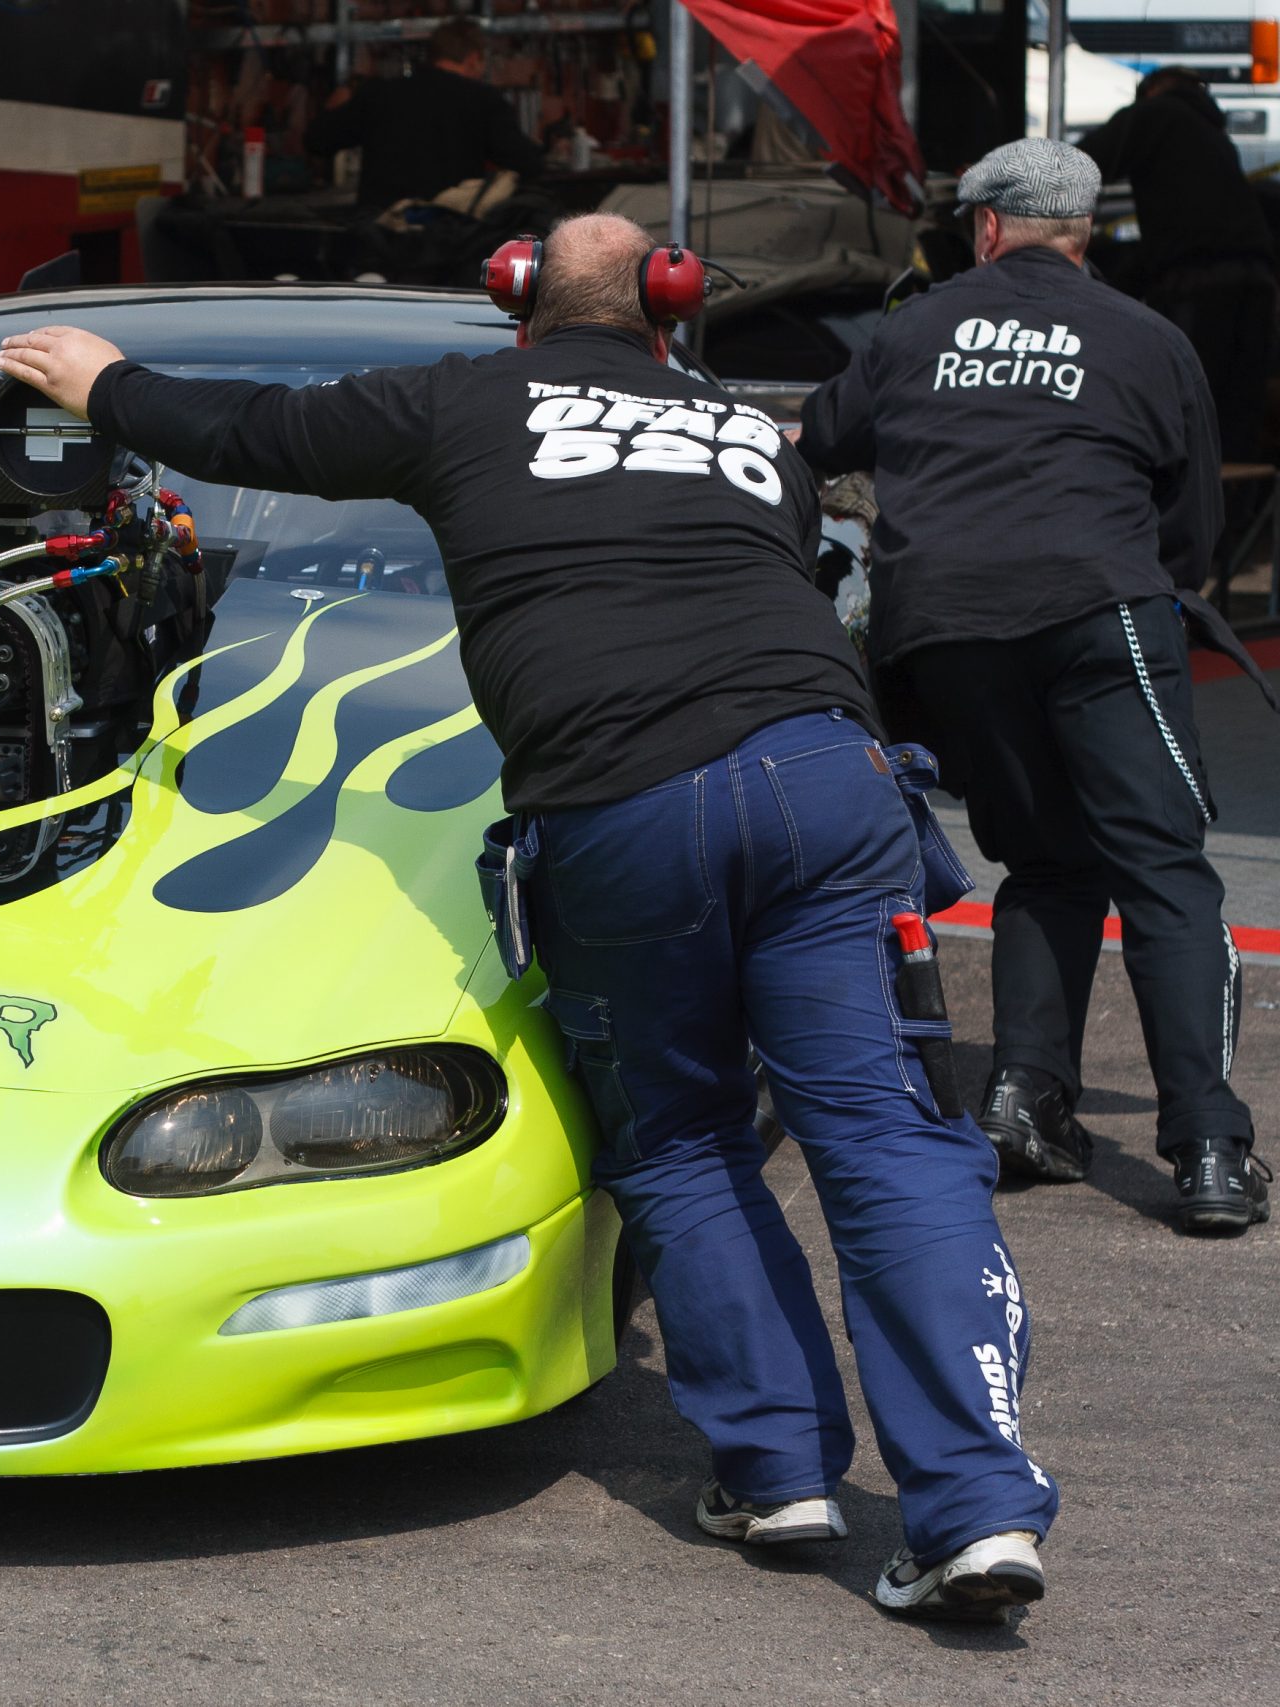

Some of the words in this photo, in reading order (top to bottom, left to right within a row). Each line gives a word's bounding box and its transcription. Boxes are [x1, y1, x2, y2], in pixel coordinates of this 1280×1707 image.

[954, 318, 1081, 357] Ofab
[527, 382, 581, 398] THE
[587, 386, 685, 406] POWER
[692, 398, 727, 413] TO
[933, 352, 1085, 400] Racing
[526, 397, 781, 459] OFAB
[528, 430, 783, 505] 520
